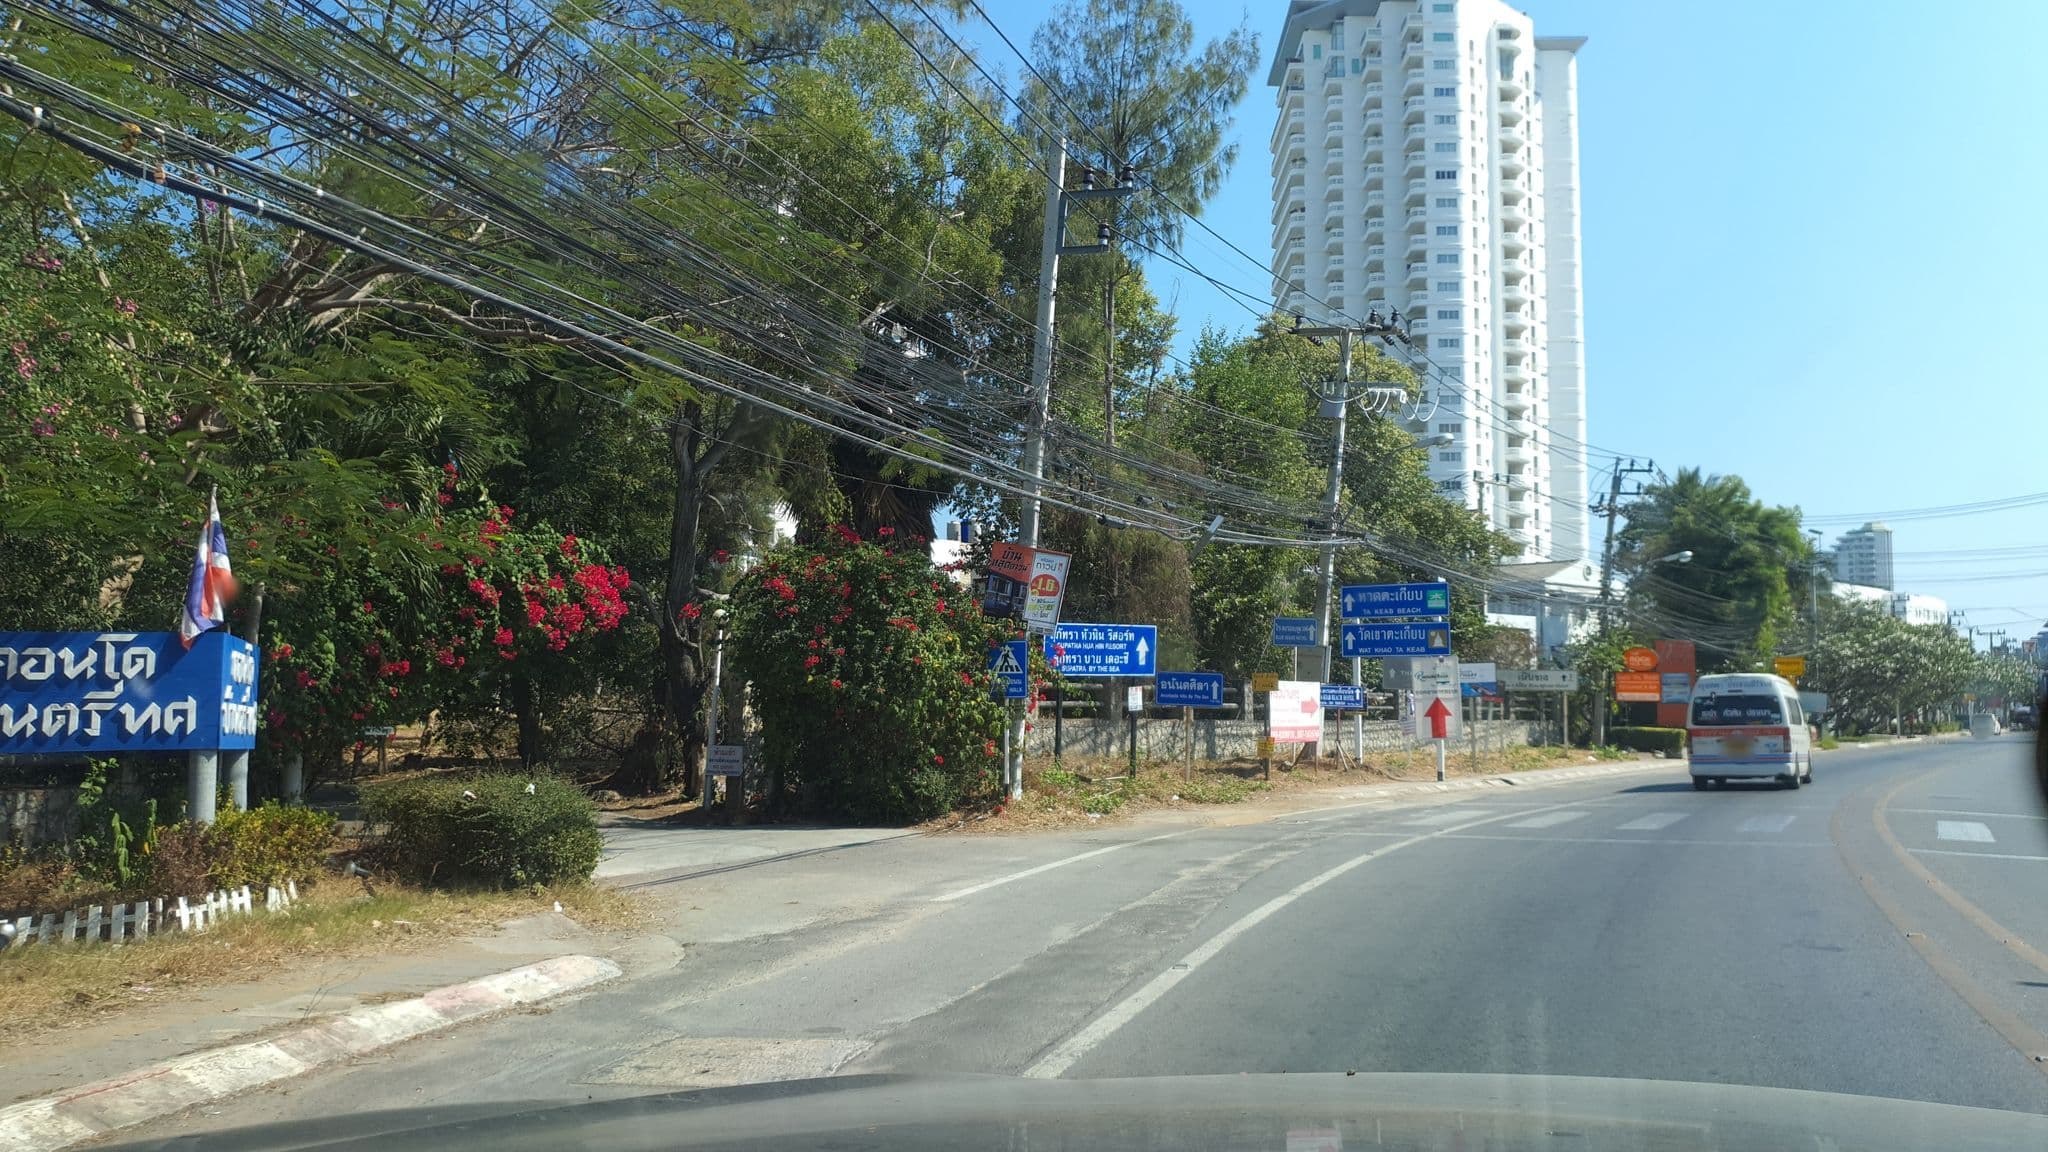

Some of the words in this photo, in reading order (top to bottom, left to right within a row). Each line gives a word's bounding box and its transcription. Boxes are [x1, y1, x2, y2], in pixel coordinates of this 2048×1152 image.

[1002, 546, 1023, 561] บ้าน
[1358, 587, 1423, 603] หาดตะเกียบ
[1081, 628, 1105, 641] หัวหิน
[1107, 629, 1135, 641] รีสอร์ท
[1358, 625, 1426, 641] วัดเขาตะเกียบ
[1084, 654, 1101, 664] บาย
[1105, 652, 1129, 664] เดอะซี
